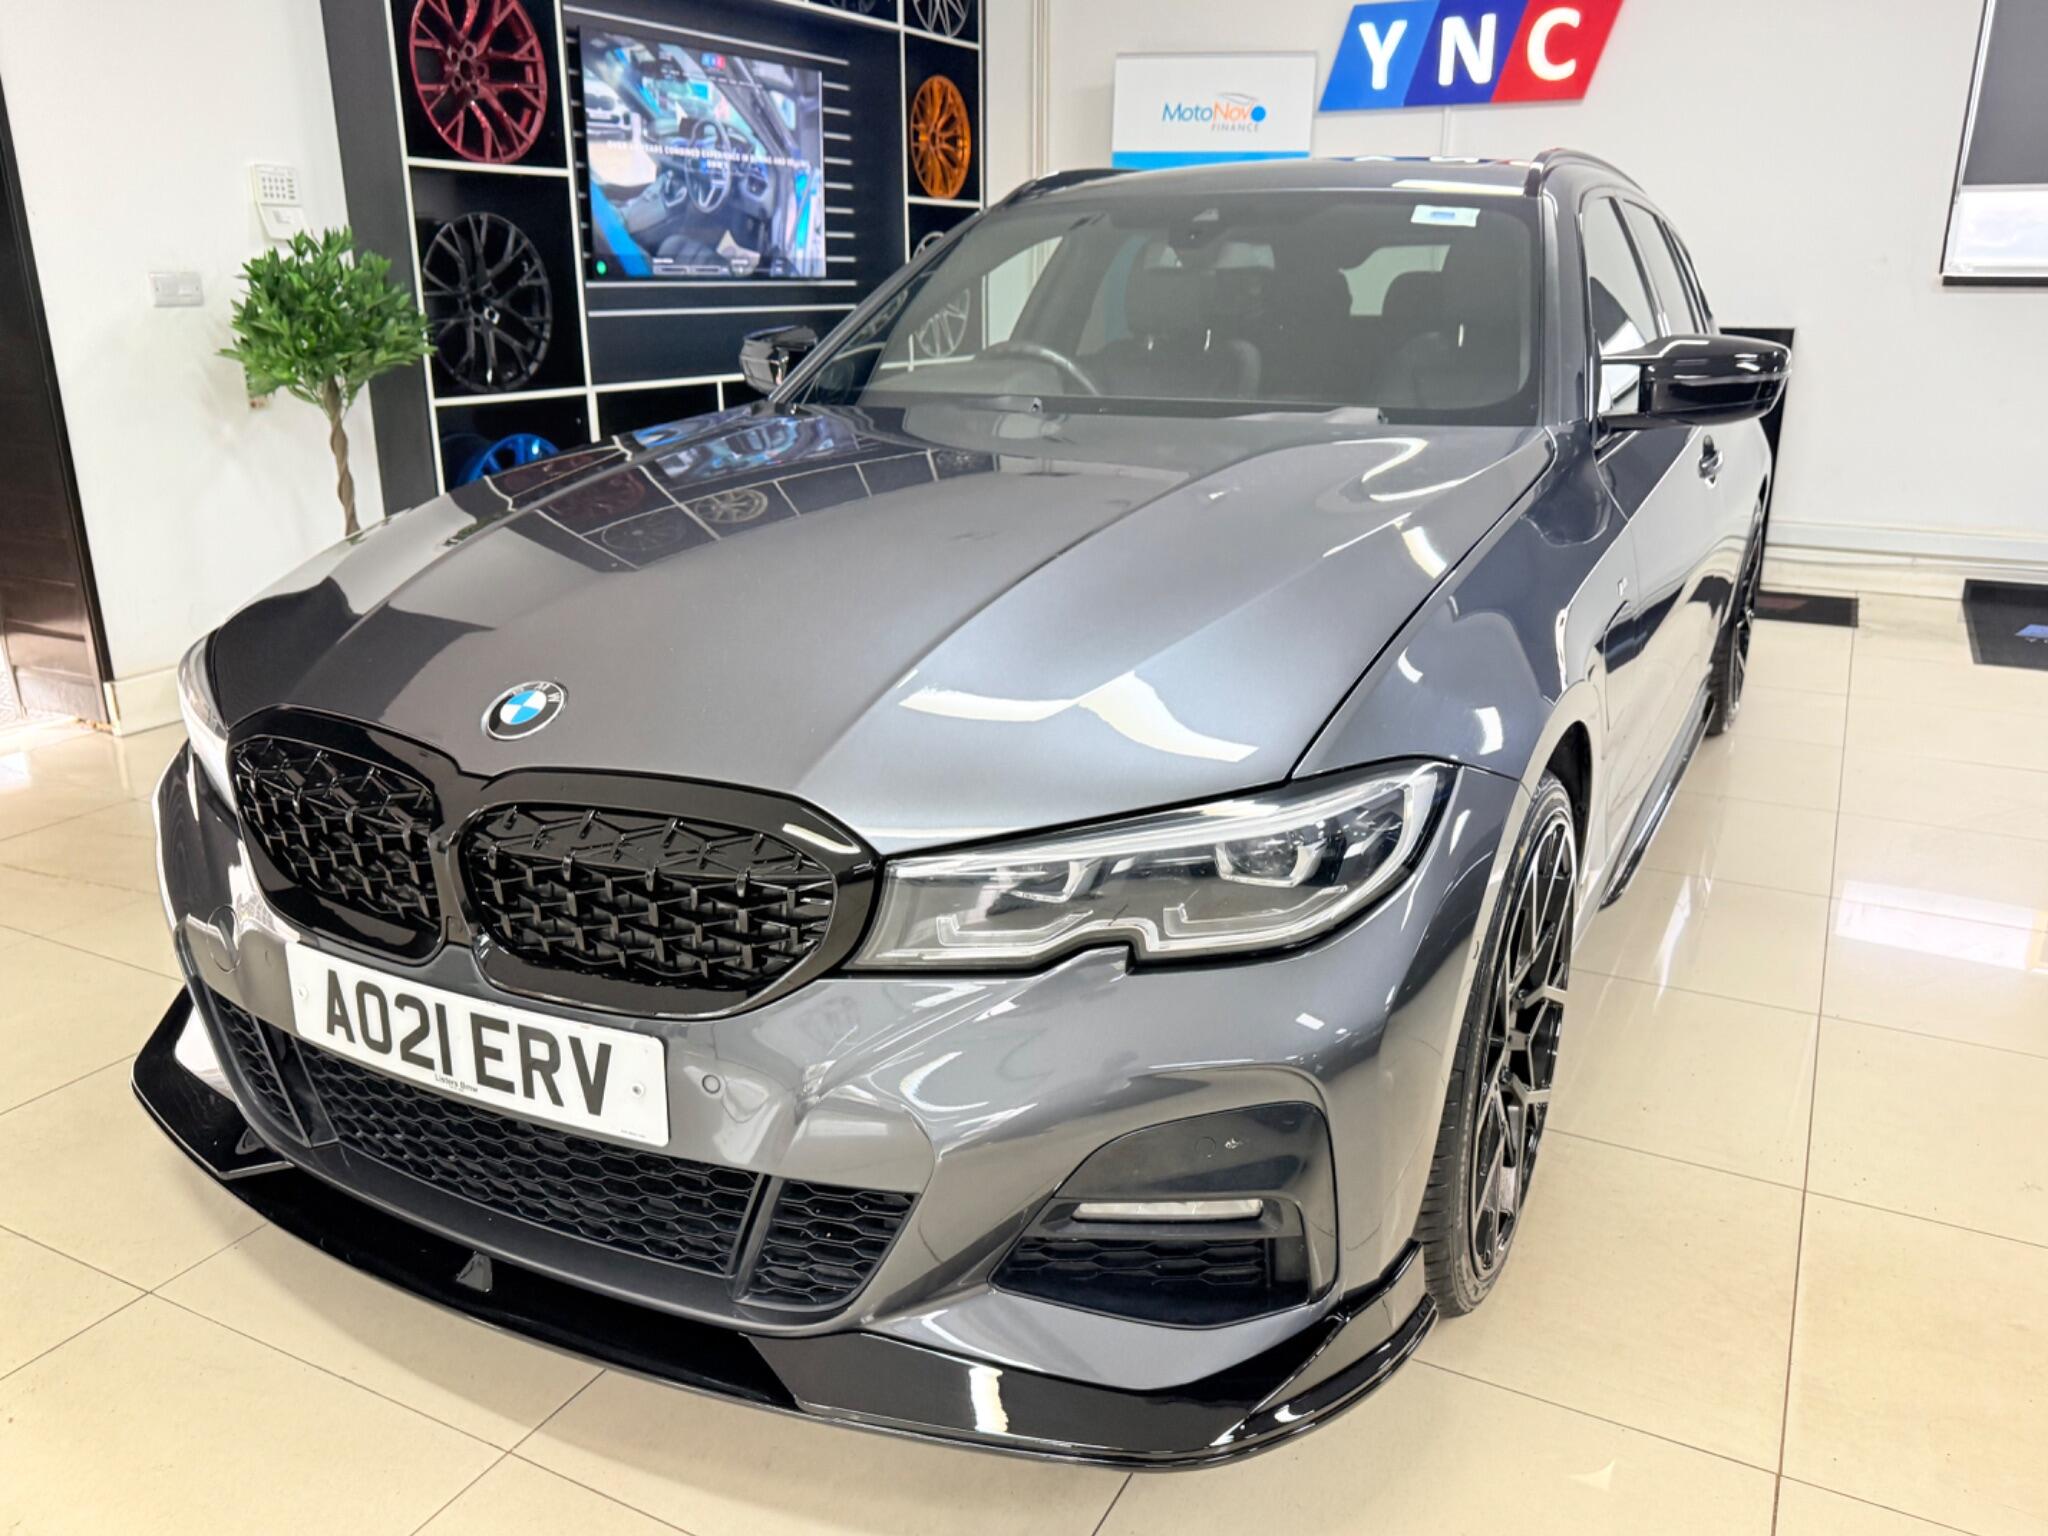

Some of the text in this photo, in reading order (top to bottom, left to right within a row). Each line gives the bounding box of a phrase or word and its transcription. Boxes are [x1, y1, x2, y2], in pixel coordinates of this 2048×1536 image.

[1358, 7, 1582, 90] YNC
[1211, 122, 1259, 133] FINANCE
[326, 969, 612, 1117] AO21 ERV
